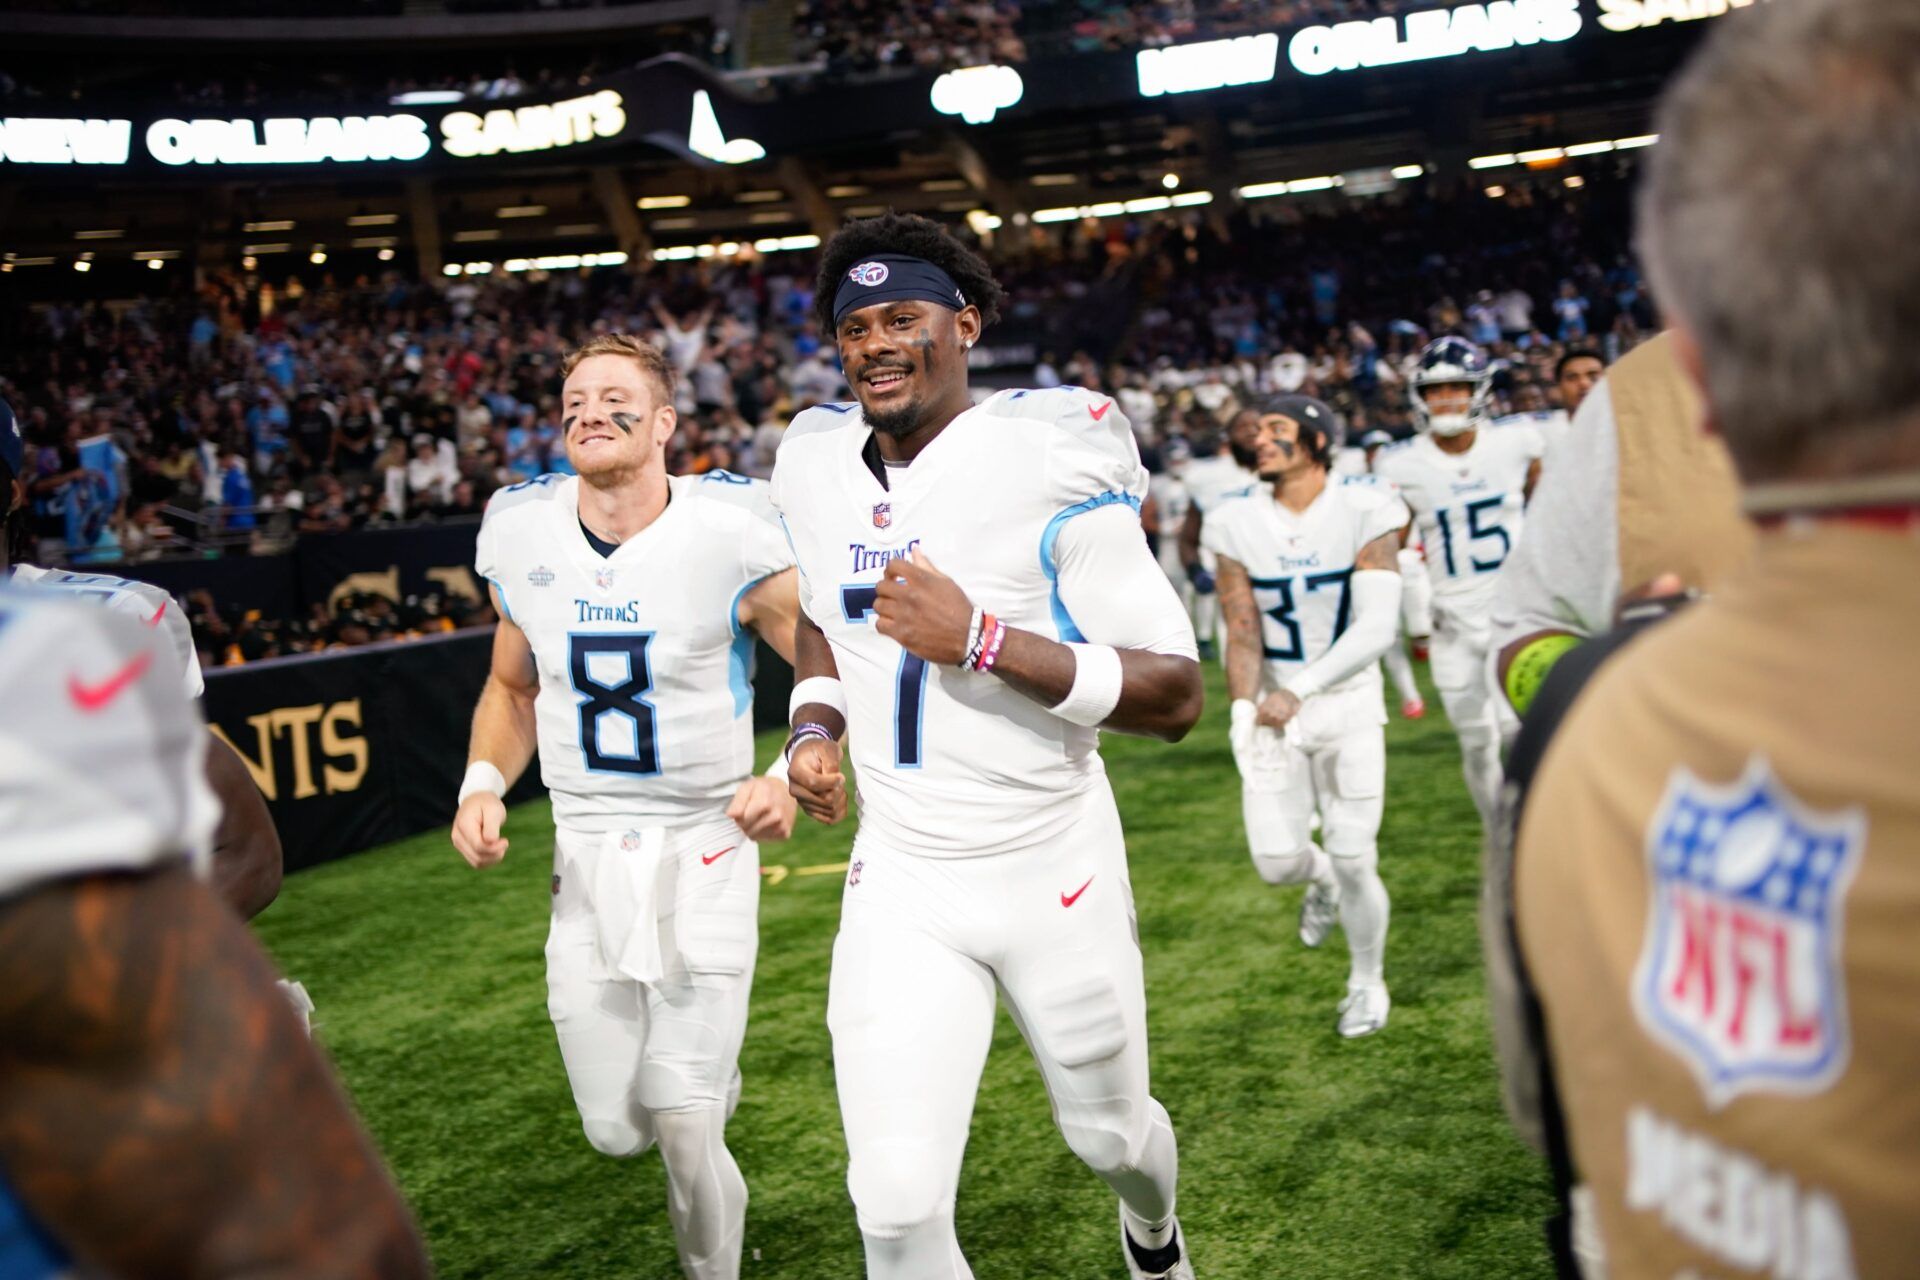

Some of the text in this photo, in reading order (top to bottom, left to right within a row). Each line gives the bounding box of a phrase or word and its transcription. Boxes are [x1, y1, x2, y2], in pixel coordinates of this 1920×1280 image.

[1136, 33, 1279, 97] NEW
[1288, 0, 1582, 76] ORLEANS
[0, 90, 626, 165] NEW ORLEANS SAINTS
[1436, 494, 1511, 577] 15
[574, 599, 639, 623] TITANS
[1249, 566, 1355, 662] 37
[567, 630, 663, 778] 8
[1671, 890, 1820, 1046] NFL
